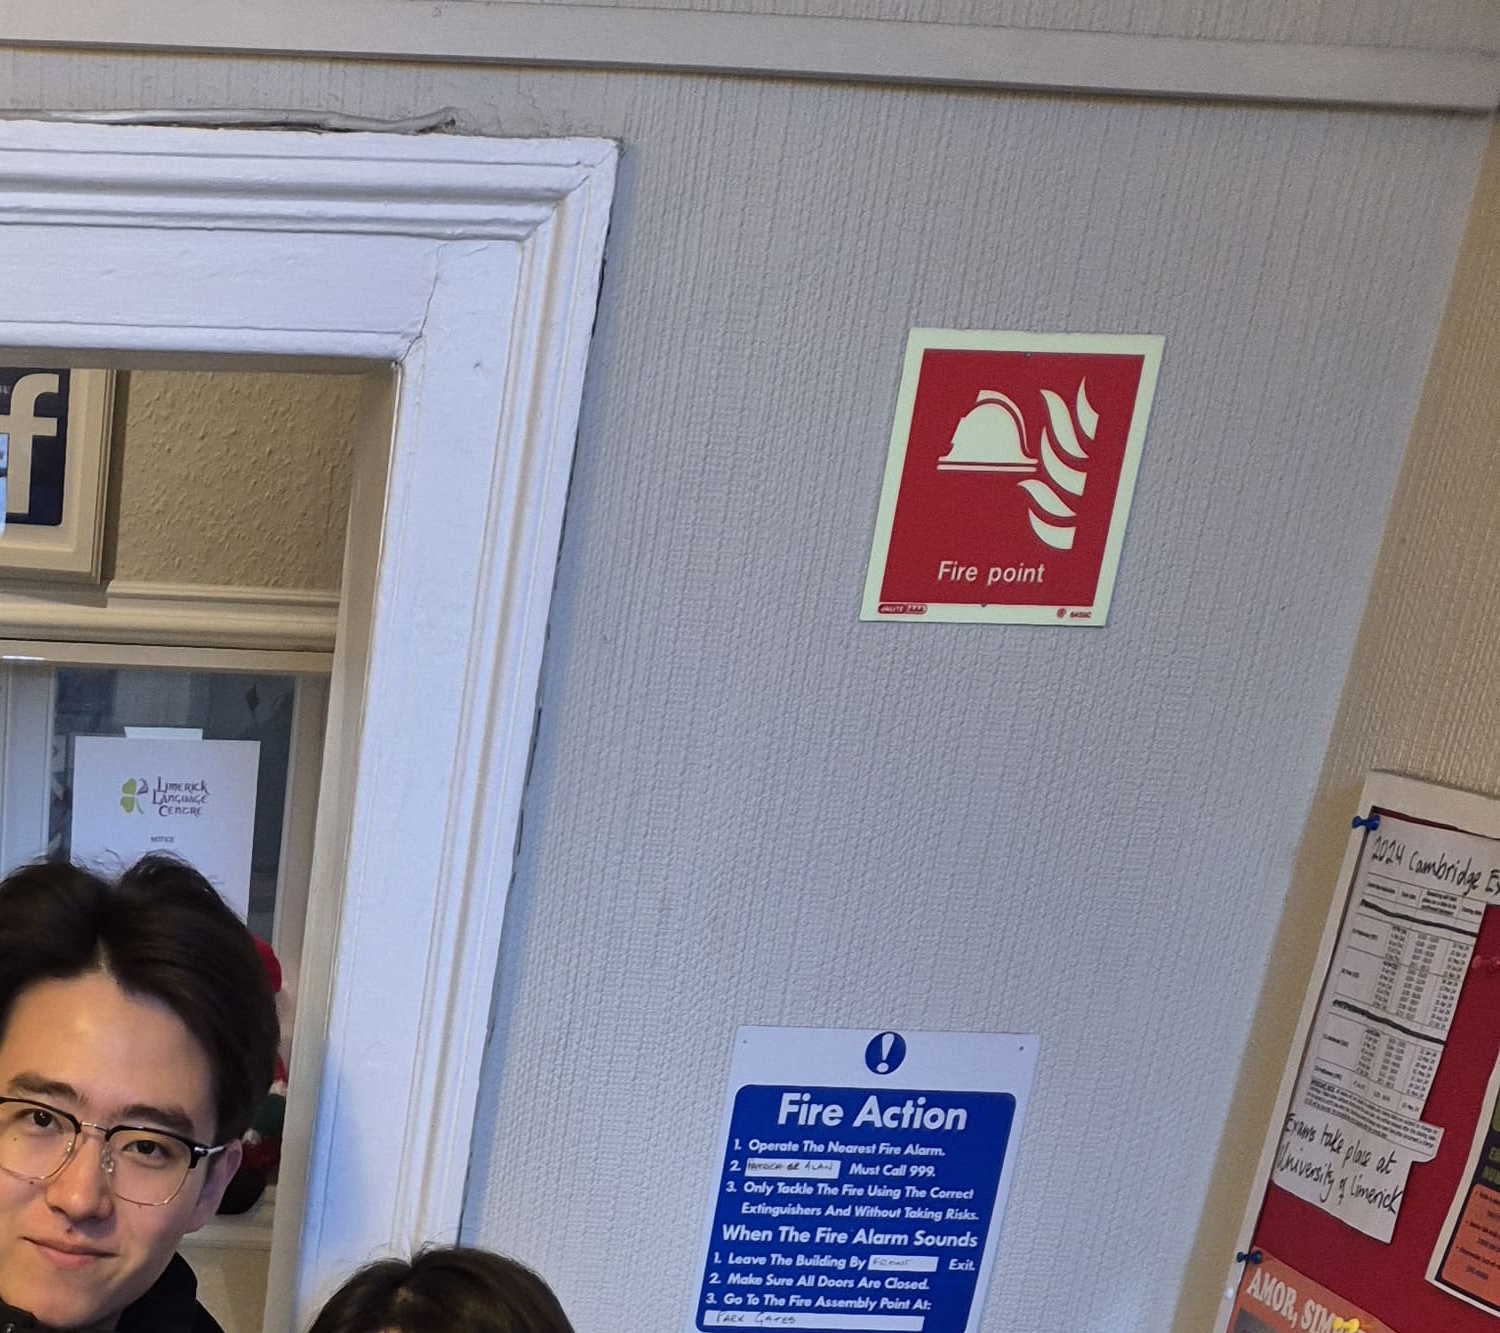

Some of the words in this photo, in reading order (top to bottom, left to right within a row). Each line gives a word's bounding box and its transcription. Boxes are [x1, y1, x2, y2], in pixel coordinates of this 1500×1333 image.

[937, 561, 978, 582] Fire
[987, 563, 1045, 586] point
[1372, 835, 1406, 865] 2024
[1409, 852, 1482, 897] Cambridge
[777, 1092, 844, 1127] Fire
[852, 1095, 968, 1131] Action
[749, 1139, 799, 1154] Operate
[802, 1140, 825, 1153] The
[827, 1141, 876, 1155] Nearest
[878, 1143, 901, 1156] Fire
[904, 1143, 946, 1157] Alarm.
[1284, 1112, 1317, 1142] Exams
[1321, 1123, 1344, 1154] take
[1342, 1139, 1372, 1168] place
[1376, 1150, 1397, 1174] at
[849, 1164, 879, 1176] Must
[883, 1165, 906, 1177] Call
[1277, 1141, 1335, 1203] University
[743, 1181, 774, 1197] Only
[776, 1183, 813, 1196] Tackle
[817, 1183, 839, 1196] The
[842, 1184, 865, 1197] Fire
[867, 1185, 901, 1200] Using
[905, 1186, 928, 1199] The
[930, 1187, 974, 1200] Correct
[741, 1203, 822, 1218] Extinguishers
[825, 1204, 851, 1217] And
[854, 1205, 902, 1219] Without
[904, 1207, 943, 1221] Taking
[945, 1208, 980, 1221] Risks.
[722, 1224, 773, 1243] When
[779, 1226, 810, 1243] The
[815, 1227, 849, 1244] Fire
[852, 1228, 908, 1246] Alarm
[913, 1230, 978, 1248] Sounds
[728, 1252, 767, 1265] Leave
[770, 1253, 792, 1266] The
[796, 1254, 846, 1270] Building
[849, 1255, 867, 1271] By
[948, 1258, 976, 1272] Exit.
[727, 1272, 763, 1286] Make
[766, 1273, 794, 1287] Sure
[796, 1274, 815, 1288] All
[817, 1275, 854, 1289] Doors
[857, 1276, 882, 1289] Are
[884, 1276, 930, 1290] Closed.
[723, 1293, 743, 1306] Go
[746, 1293, 760, 1306] To
[763, 1294, 785, 1307] The
[788, 1295, 812, 1307] Fire
[814, 1295, 876, 1311] Assembly
[879, 1298, 912, 1310] Point
[914, 1298, 932, 1311] At:
[1246, 1267, 1298, 1328] AMOR,
